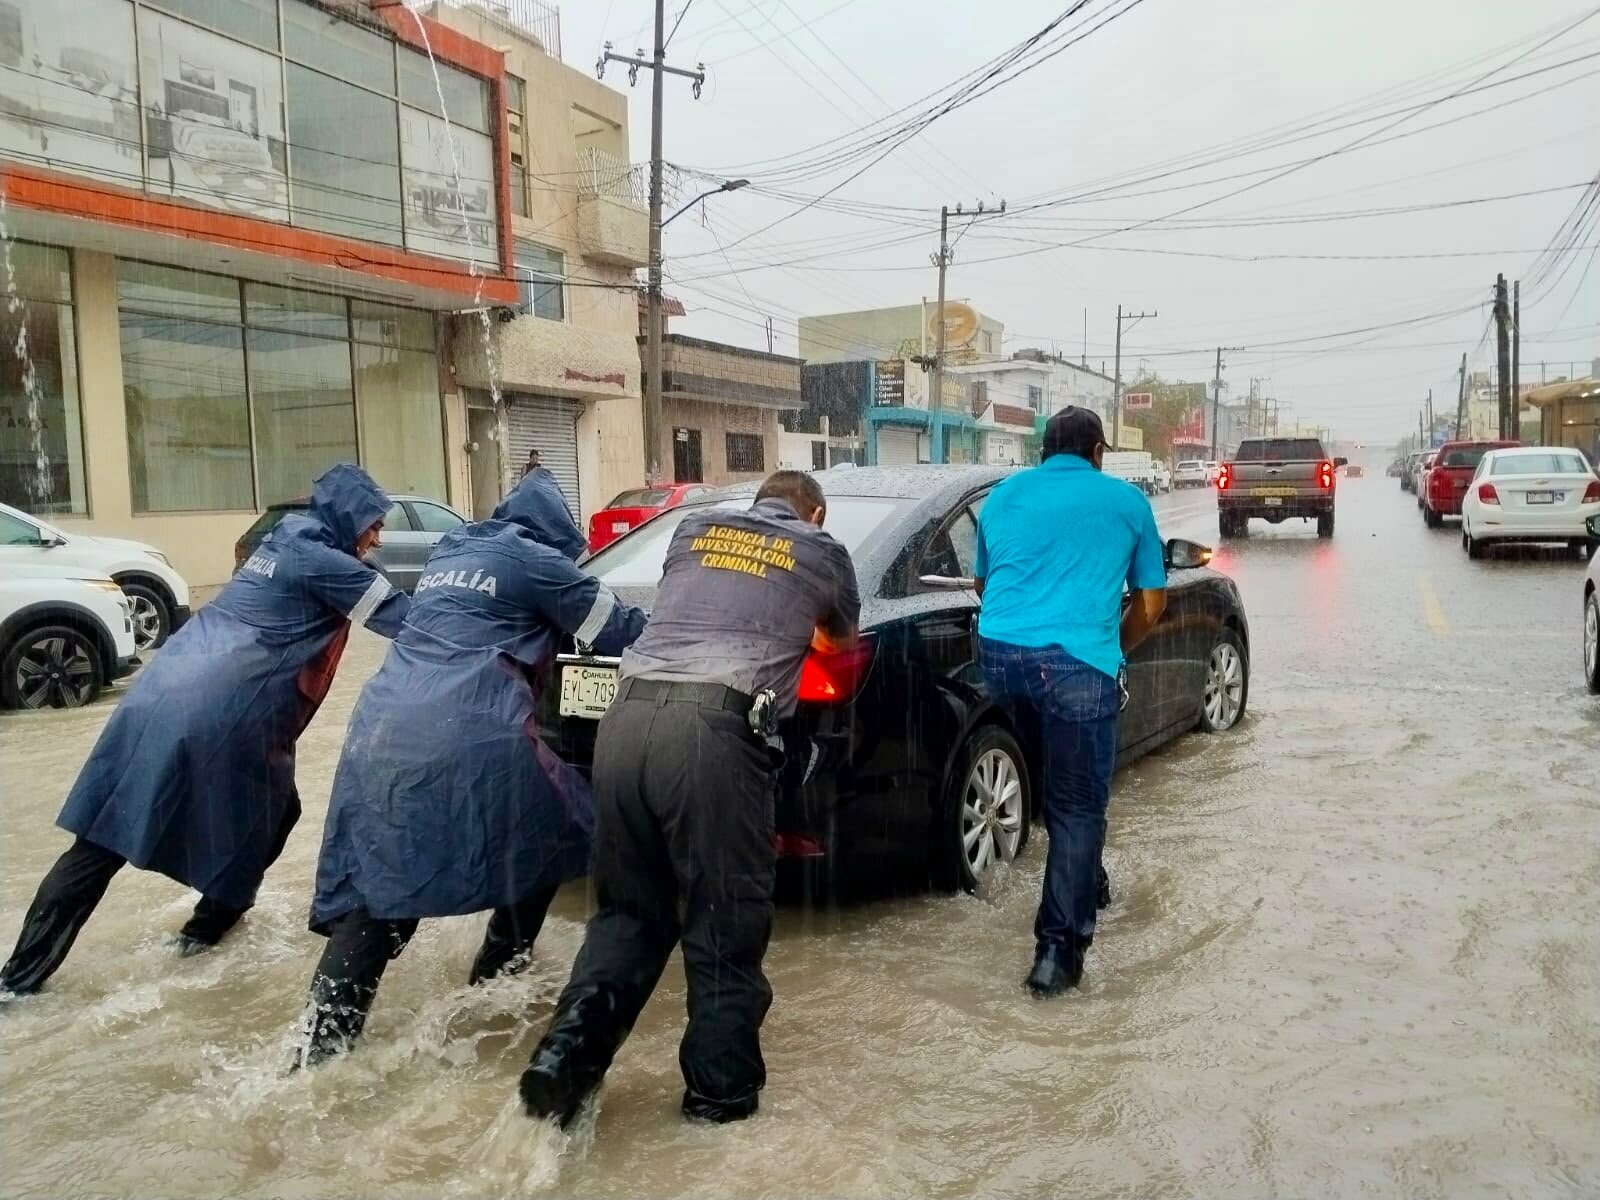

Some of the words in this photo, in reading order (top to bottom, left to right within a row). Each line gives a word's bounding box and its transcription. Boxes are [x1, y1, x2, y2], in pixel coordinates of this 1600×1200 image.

[706, 525, 767, 546] AGENCIA
[772, 538, 793, 553] DE
[690, 537, 796, 571] INVESTIGACION
[701, 553, 767, 578] CRIMINAL
